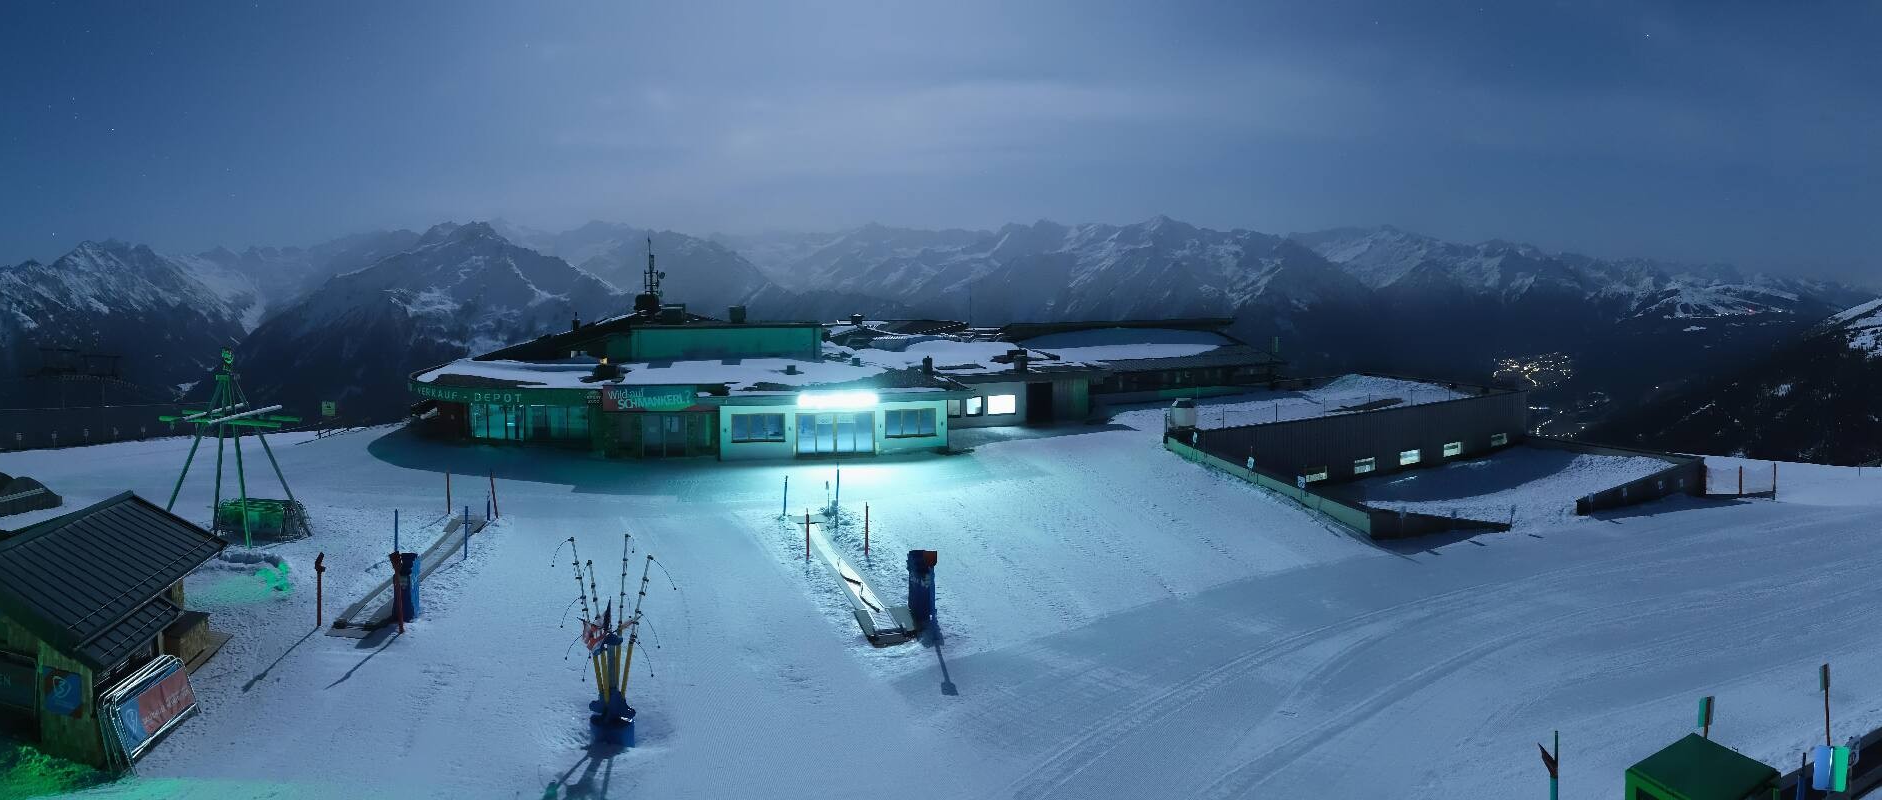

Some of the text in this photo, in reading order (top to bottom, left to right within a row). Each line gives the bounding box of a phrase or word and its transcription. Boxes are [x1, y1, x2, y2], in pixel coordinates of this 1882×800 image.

[417, 386, 458, 400] VERKAUF
[474, 392, 522, 403] DEPOT
[608, 389, 628, 400] Wild
